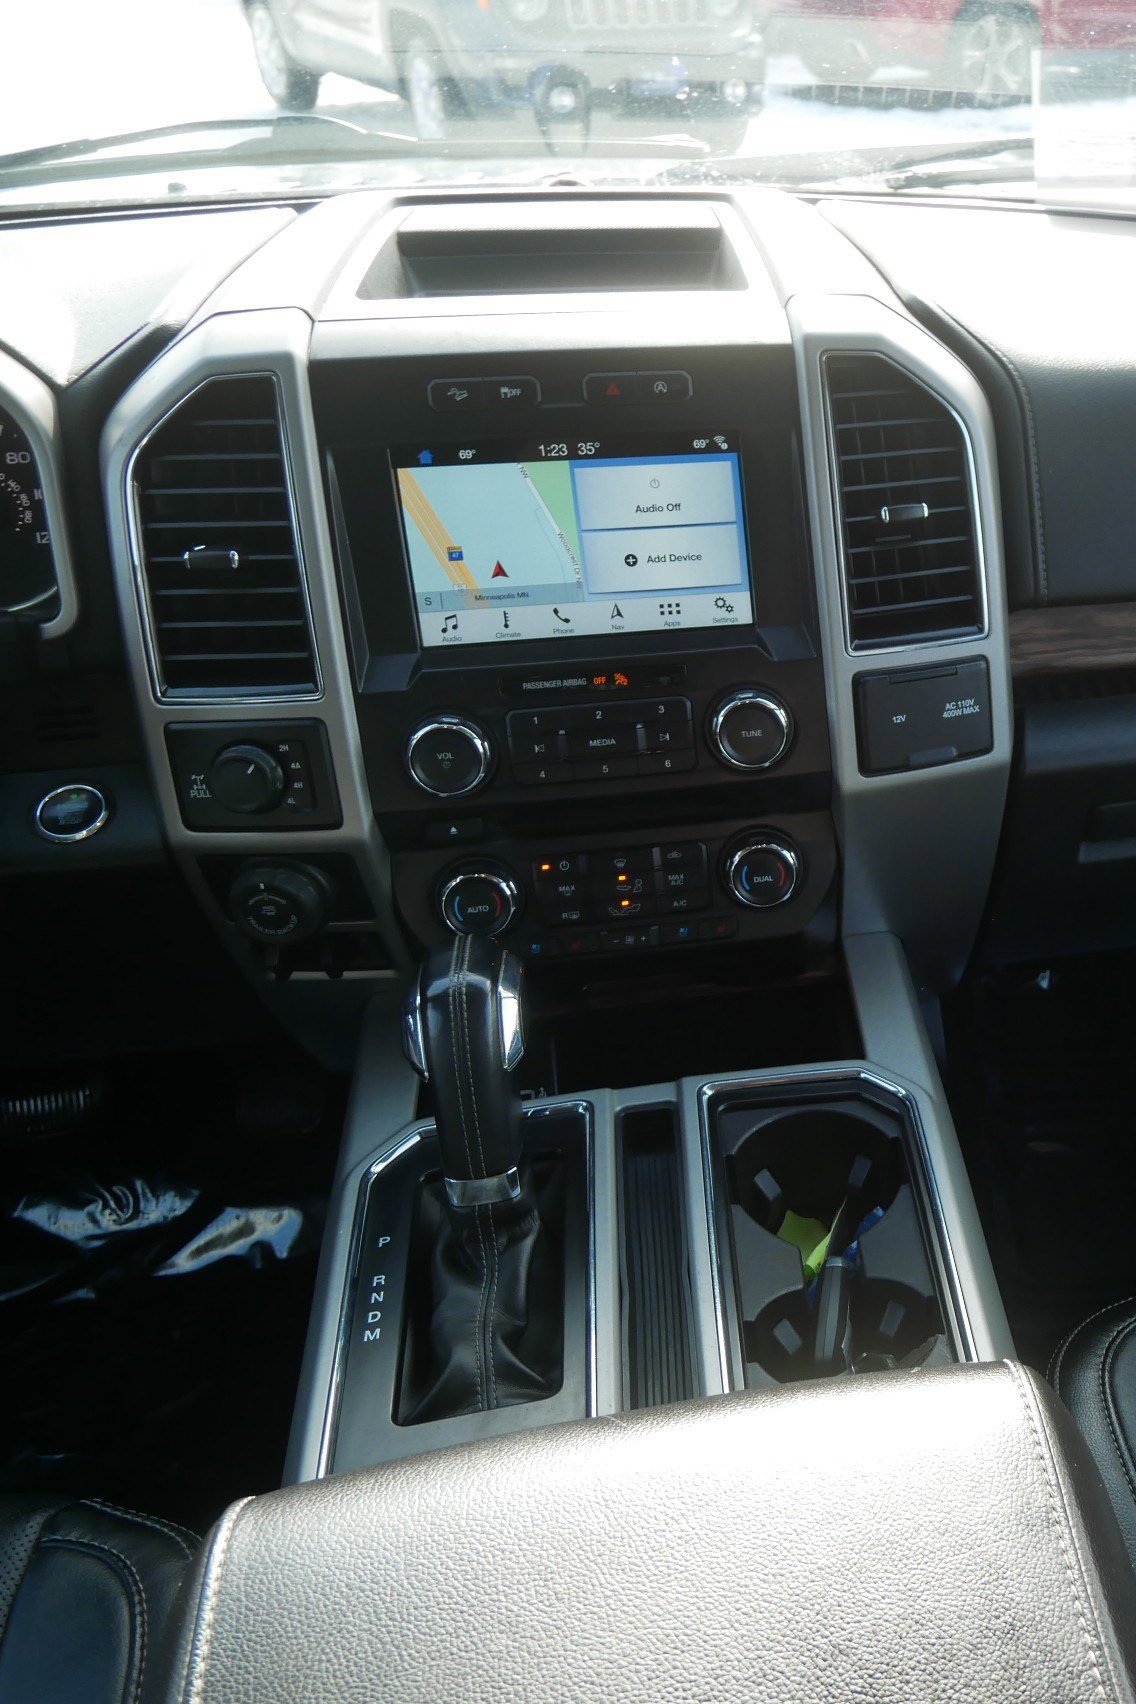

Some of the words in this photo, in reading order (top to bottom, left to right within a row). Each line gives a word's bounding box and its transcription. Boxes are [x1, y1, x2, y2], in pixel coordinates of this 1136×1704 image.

[539, 444, 568, 457] 1:23
[6, 452, 30, 464] 80
[635, 503, 664, 513] Audio
[666, 503, 682, 512] Off
[558, 531, 579, 566] Woodcrest
[646, 554, 667, 564] Add
[669, 553, 703, 563] Device
[424, 596, 432, 606] S
[474, 592, 516, 602] Minneapolis
[663, 619, 681, 628] Apps
[712, 616, 739, 625] Settings
[552, 626, 575, 635] Phone
[611, 623, 625, 631] Nav
[442, 634, 462, 643] Audio
[495, 630, 522, 639] Climate
[522, 679, 562, 690] PASSENGER
[562, 677, 587, 687] AIRBAG
[593, 676, 608, 685] OFF
[945, 702, 957, 710] AC
[957, 697, 976, 708] 110V
[658, 705, 665, 714] 3
[942, 708, 963, 719] 400W
[962, 704, 980, 715] MAX
[595, 710, 602, 719] 2
[891, 714, 907, 724] 12V
[533, 717, 538, 725] 1
[741, 729, 763, 738] TUNE
[589, 737, 616, 747] MEDIA
[278, 744, 289, 752] 2H
[436, 751, 455, 760] VOL
[664, 759, 671, 768] 6
[602, 764, 609, 773] 5
[539, 770, 546, 779] 4
[190, 789, 212, 798] PULL
[667, 873, 685, 882] MAX
[753, 875, 774, 883] DUAL
[558, 884, 576, 893] MAX
[672, 900, 688, 908] A/C
[467, 905, 490, 914] AUTO
[378, 1236, 391, 1248] P
[372, 1275, 386, 1287] R
[370, 1291, 384, 1304] N
[367, 1311, 381, 1323] D
[363, 1328, 381, 1342] M
